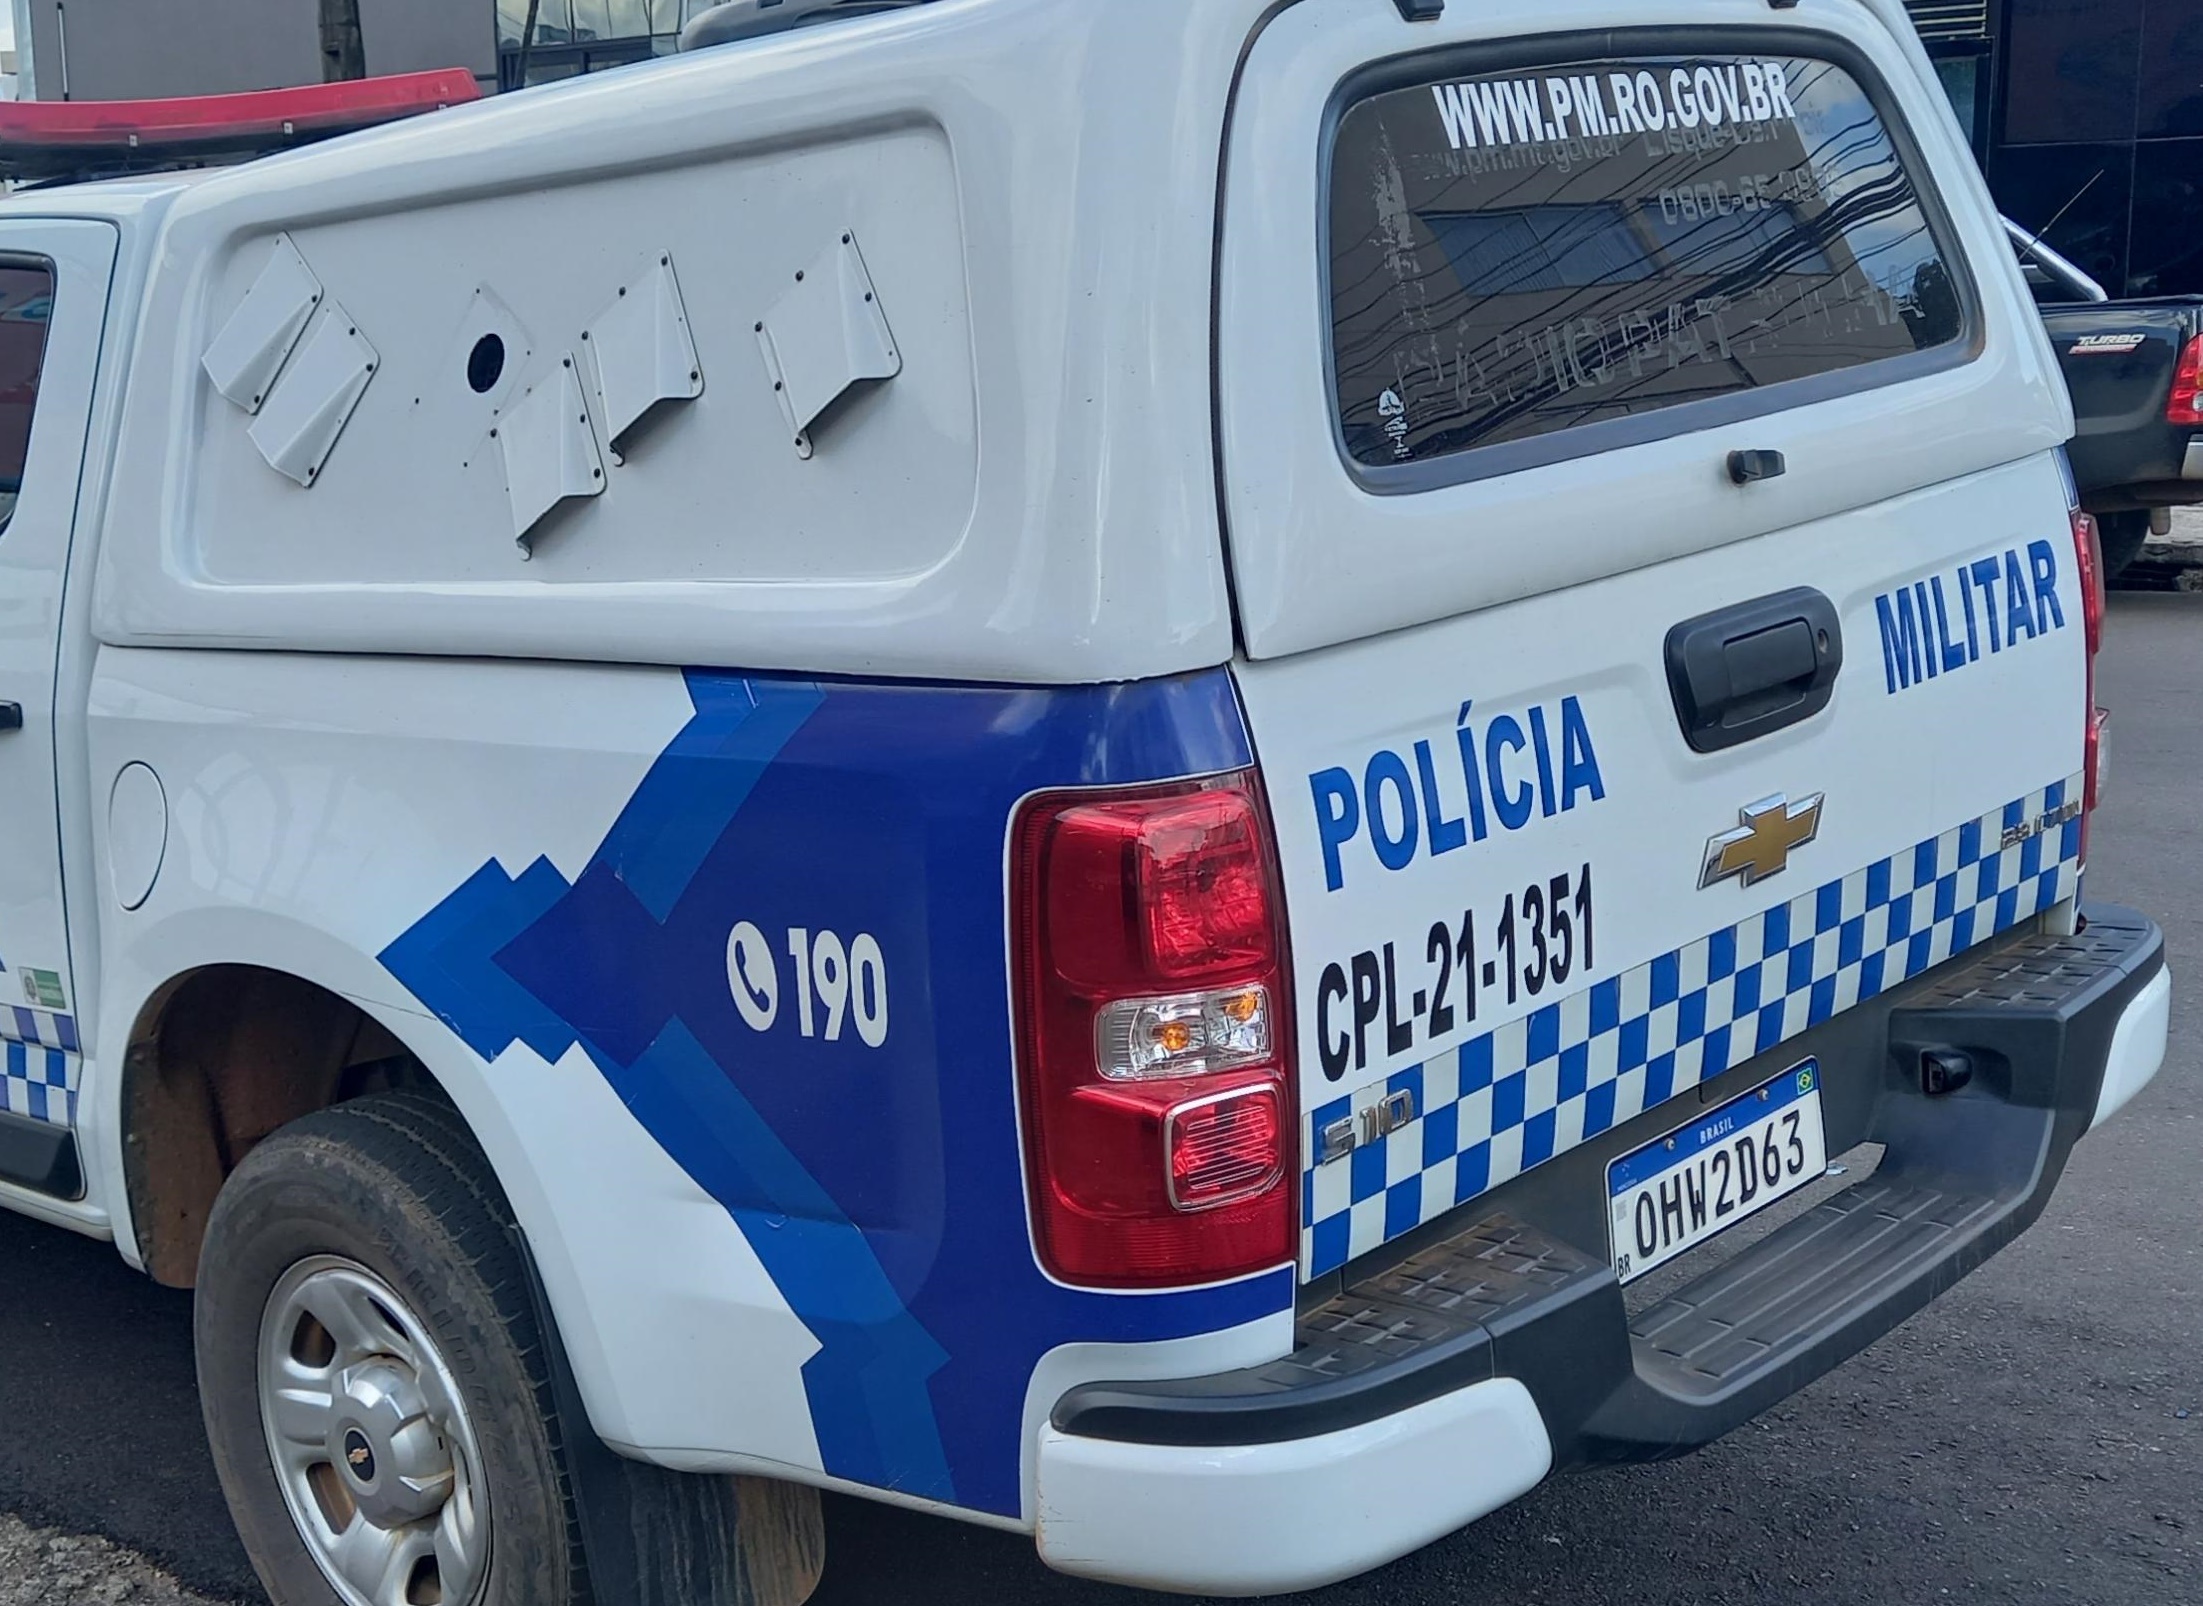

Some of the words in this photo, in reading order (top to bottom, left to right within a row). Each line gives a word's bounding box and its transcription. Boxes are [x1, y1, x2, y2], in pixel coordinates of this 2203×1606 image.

[1431, 62, 1796, 149] WWW.PM.RO.GOV.BR
[2077, 333, 2147, 346] TURBO
[1309, 695, 1606, 892] POLÍCIA
[1875, 540, 2065, 694] MILITAR
[788, 927, 888, 1048] 190
[1316, 862, 1593, 1082] CPL-21-1351
[1319, 1088, 1414, 1166] S10
[1700, 1116, 1735, 1145] BRASIL
[1634, 1109, 1805, 1259] OHW2D63
[1617, 1254, 1631, 1277] BR
